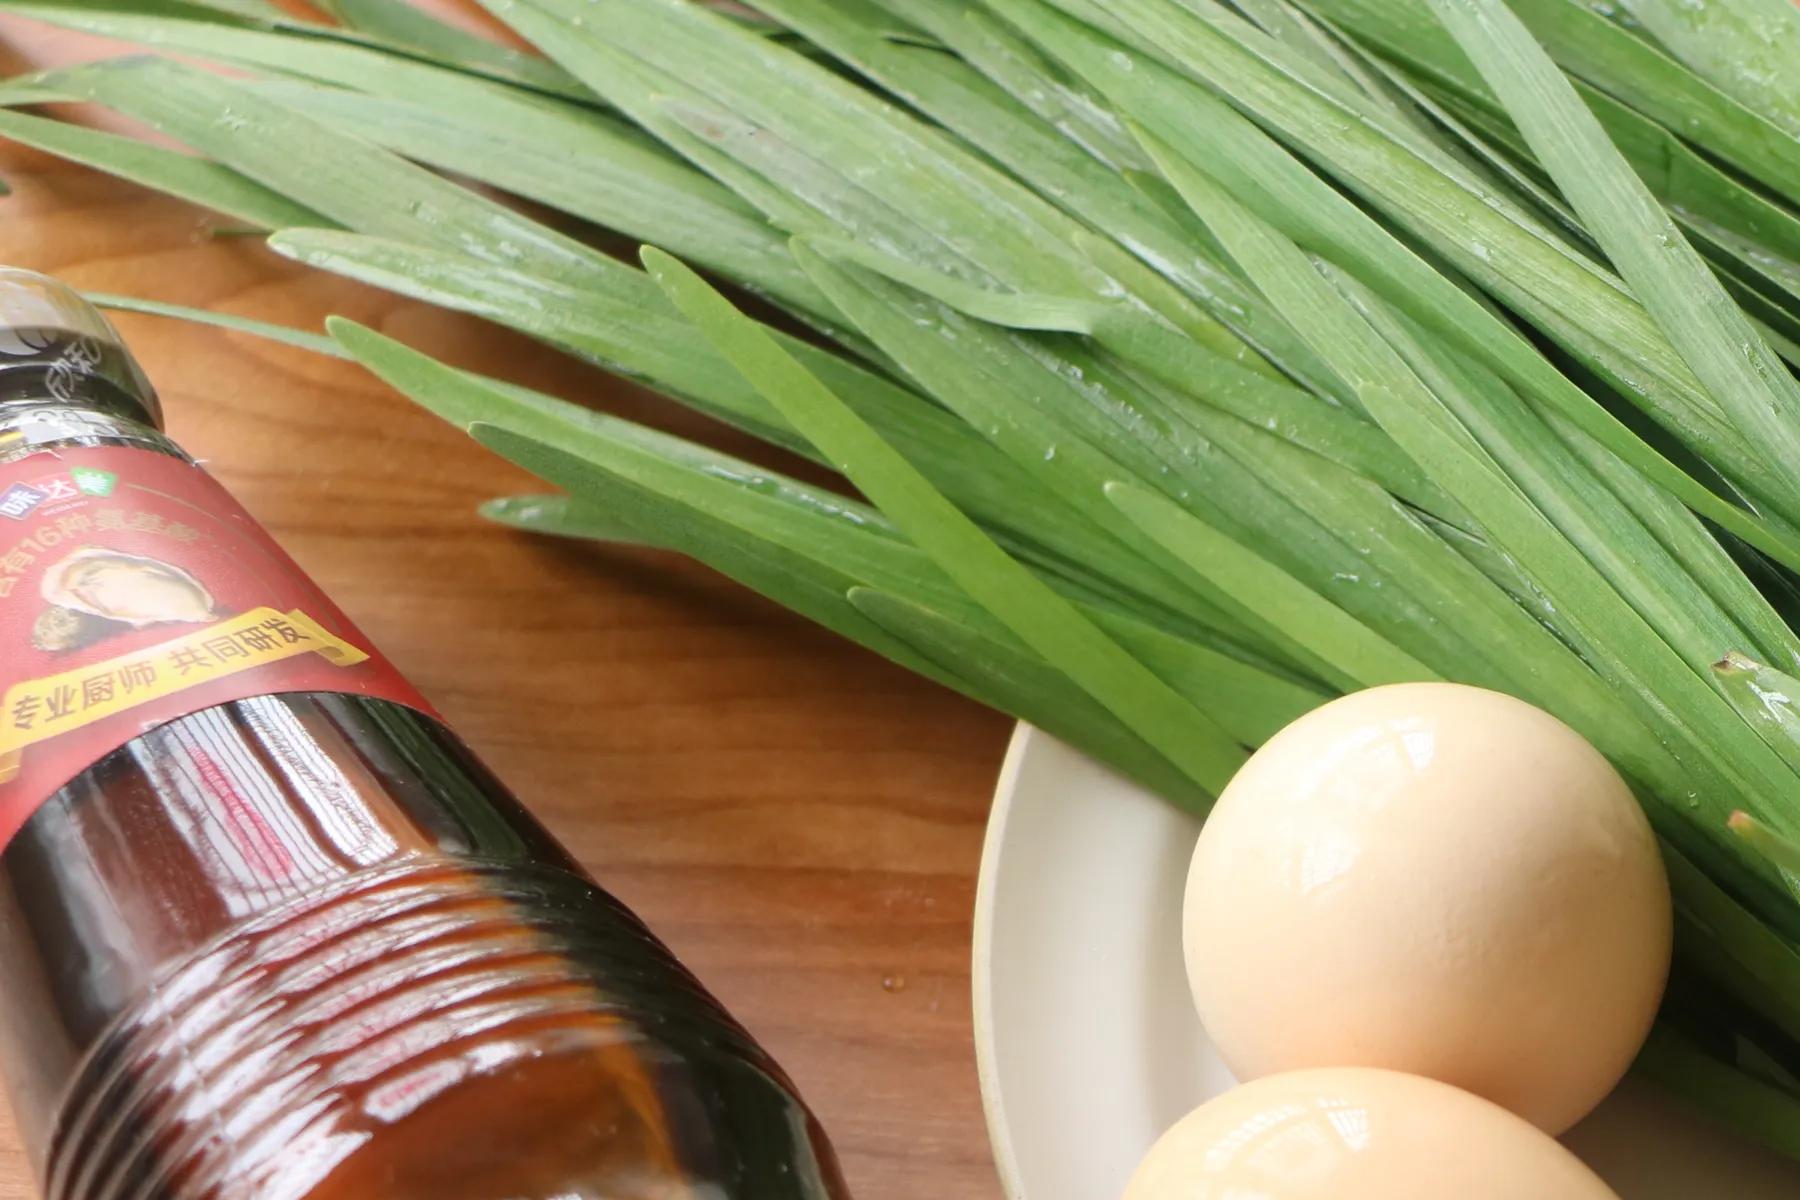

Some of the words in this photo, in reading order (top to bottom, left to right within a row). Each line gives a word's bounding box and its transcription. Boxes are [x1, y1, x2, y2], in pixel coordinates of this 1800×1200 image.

[10, 660, 157, 731] 专业厨师
[167, 616, 311, 677] 共同研发
